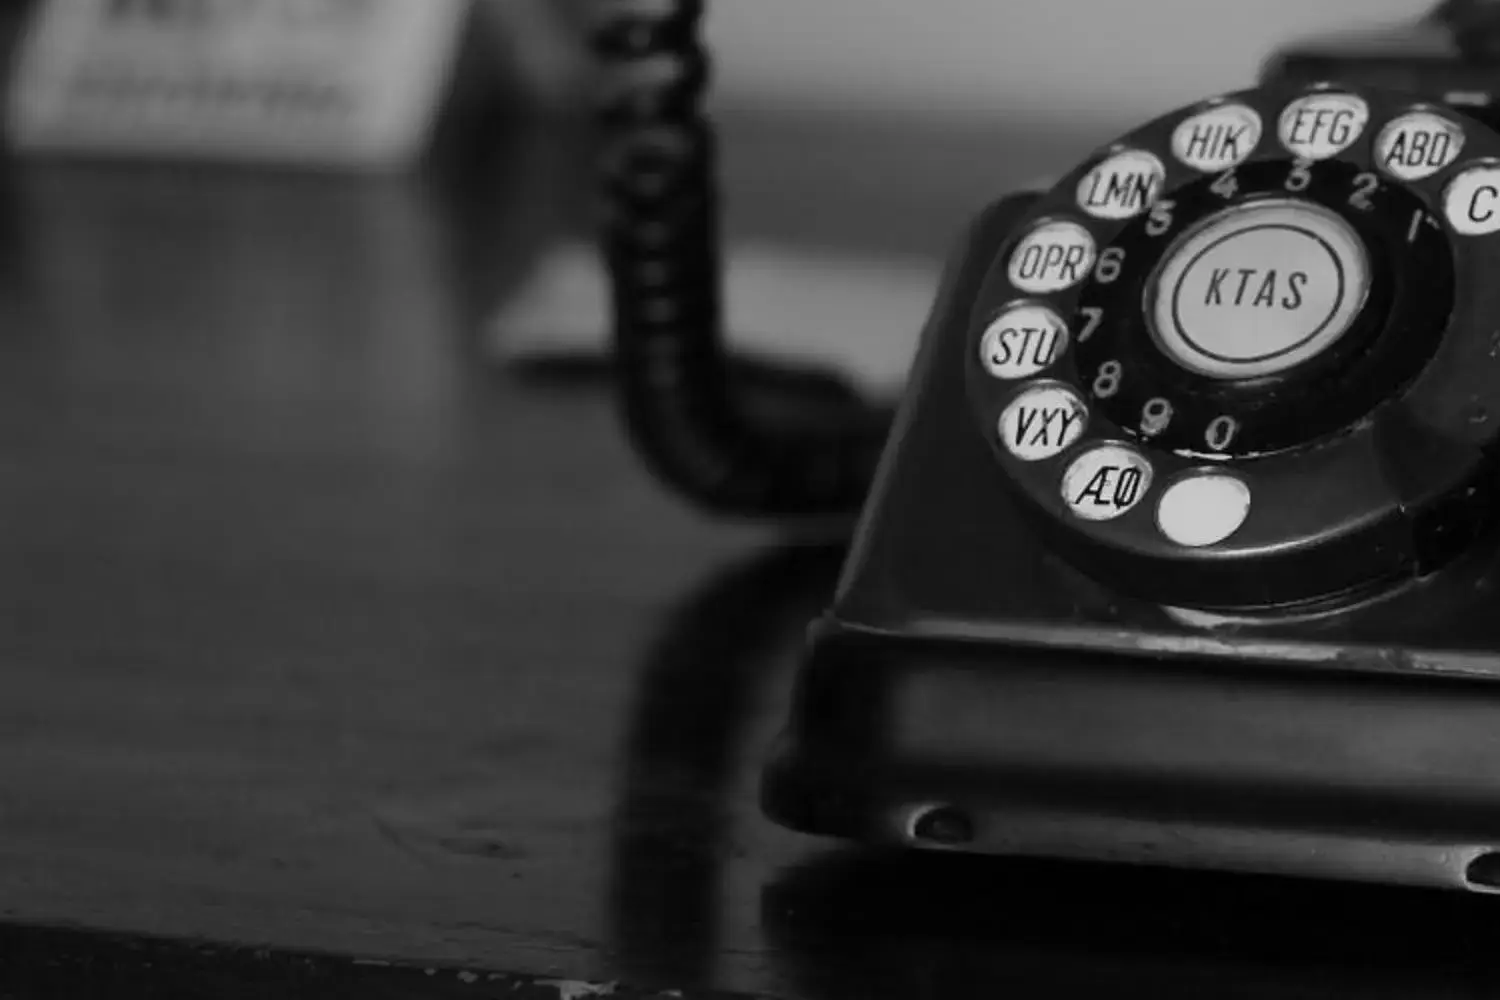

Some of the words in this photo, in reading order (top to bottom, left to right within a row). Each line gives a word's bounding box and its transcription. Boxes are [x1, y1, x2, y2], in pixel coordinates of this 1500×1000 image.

[1185, 124, 1248, 160] HIK
[1290, 109, 1354, 145] EFG
[1385, 131, 1451, 167] ABD
[1084, 173, 1153, 208] LMN
[1208, 167, 1239, 199] 4
[1343, 172, 1373, 210] 2
[1145, 199, 1177, 236] 5
[1469, 186, 1497, 222] C
[1019, 245, 1084, 281] OPR
[1096, 246, 1126, 283] 6
[1205, 269, 1306, 309] KTAS
[991, 324, 1059, 362] STU
[1078, 309, 1103, 341] 7
[1093, 360, 1121, 398] 8
[1016, 408, 1076, 446] VXY
[1140, 398, 1172, 434] 9
